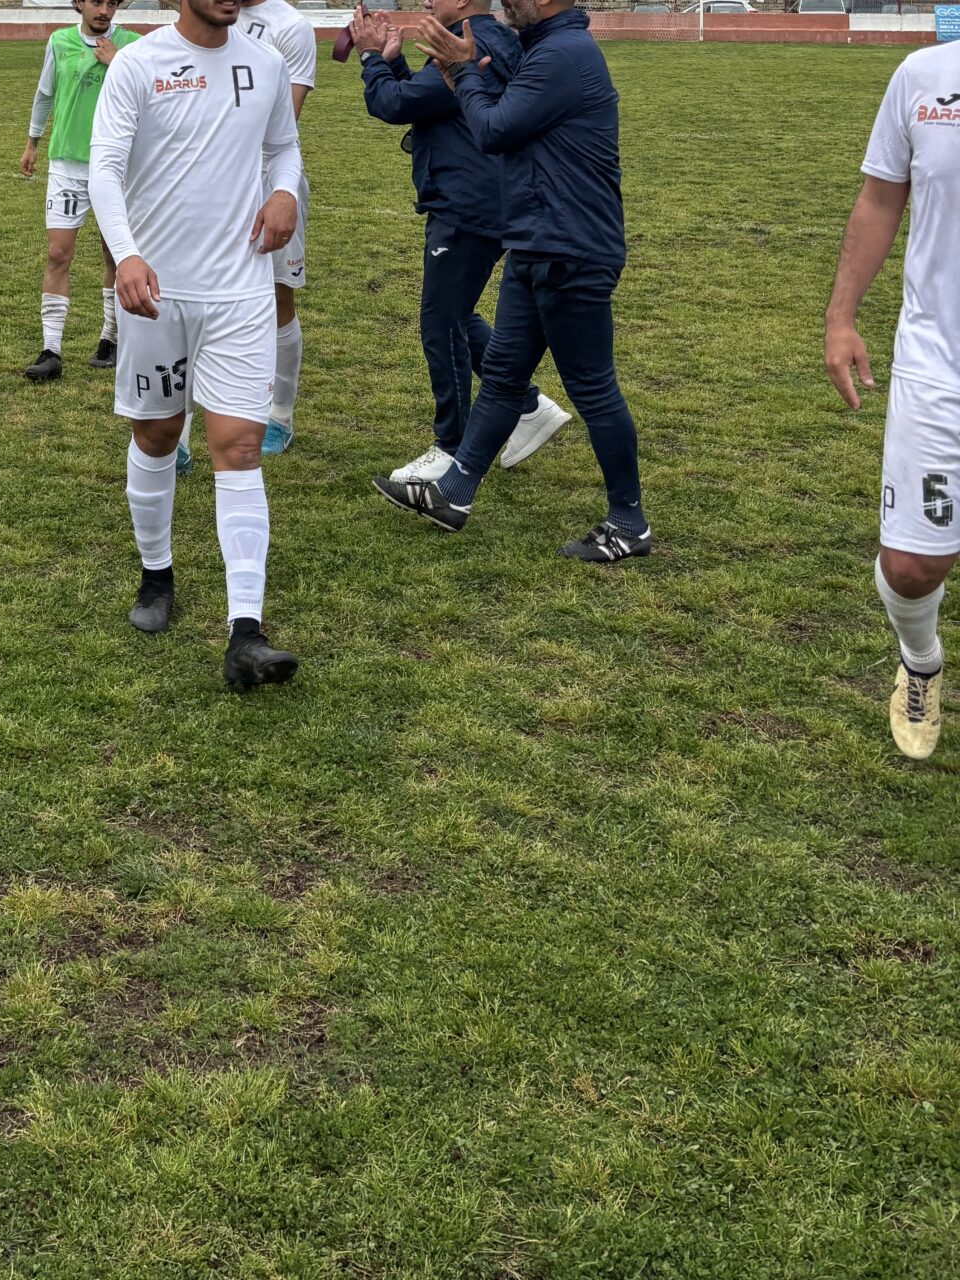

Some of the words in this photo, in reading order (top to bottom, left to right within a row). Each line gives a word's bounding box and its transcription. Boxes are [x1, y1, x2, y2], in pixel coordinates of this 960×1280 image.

[155, 75, 207, 94] BARRUS
[231, 65, 254, 108] P
[62, 192, 78, 216] 11
[136, 373, 151, 398] P
[883, 485, 895, 521] P
